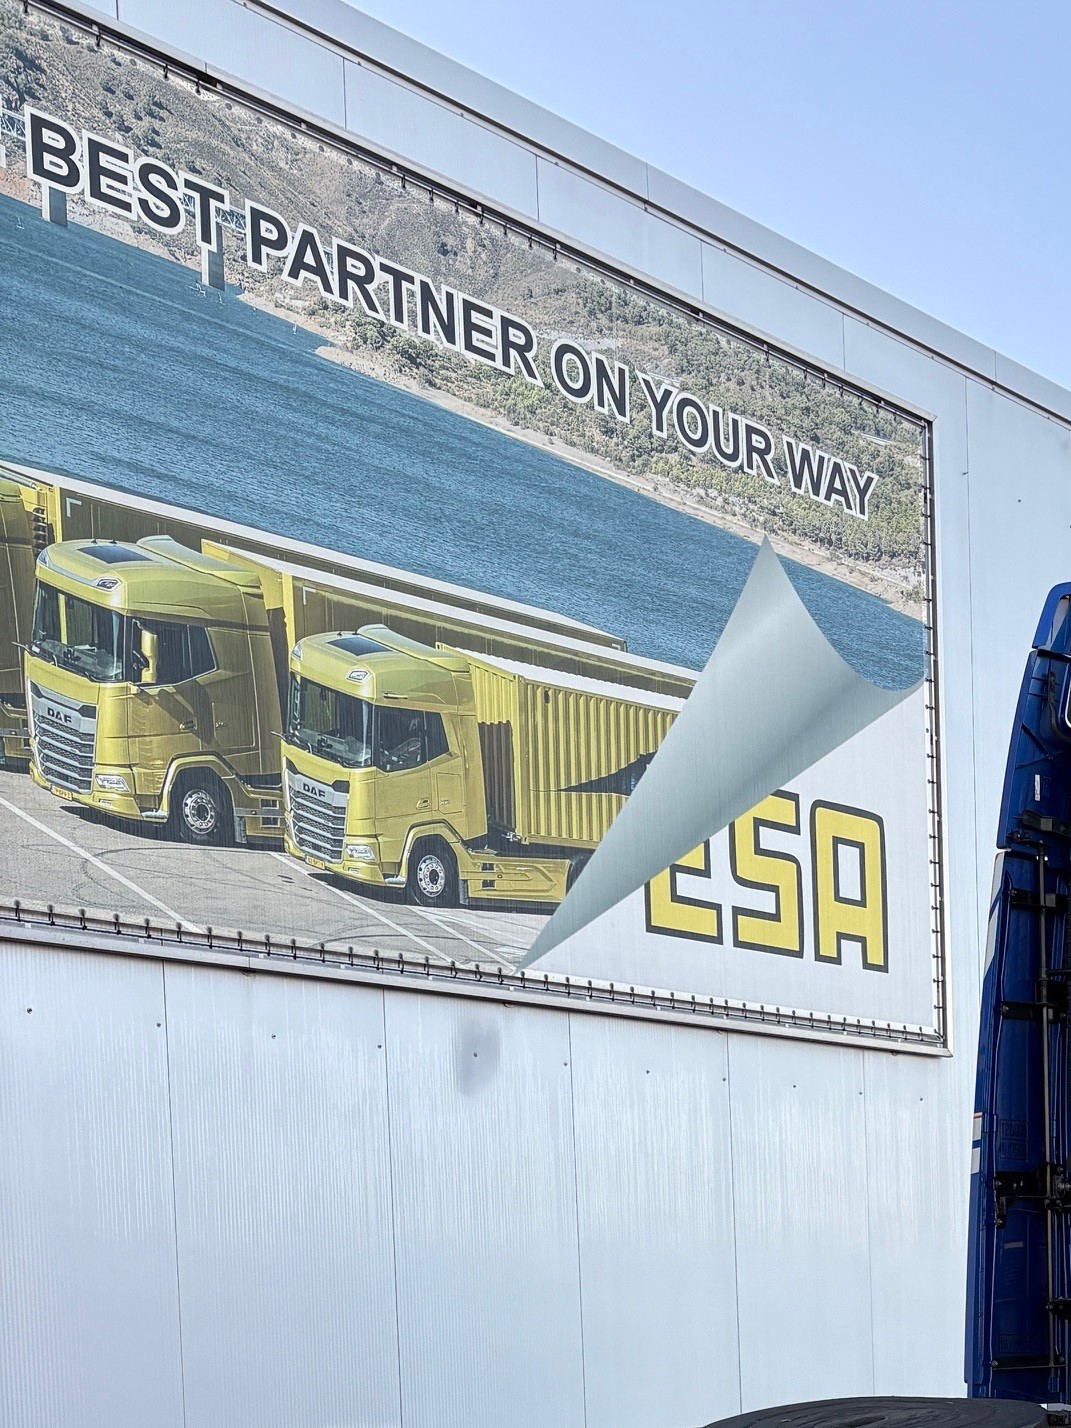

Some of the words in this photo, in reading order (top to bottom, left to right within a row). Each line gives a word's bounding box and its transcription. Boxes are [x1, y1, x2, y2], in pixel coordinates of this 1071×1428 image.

[29, 110, 226, 247] BEST
[249, 204, 540, 385] PARTNER
[554, 341, 629, 420] ON
[640, 374, 778, 482] YOUR
[786, 439, 875, 518] WAY
[47, 706, 72, 724] DAF
[302, 782, 326, 798] DAF
